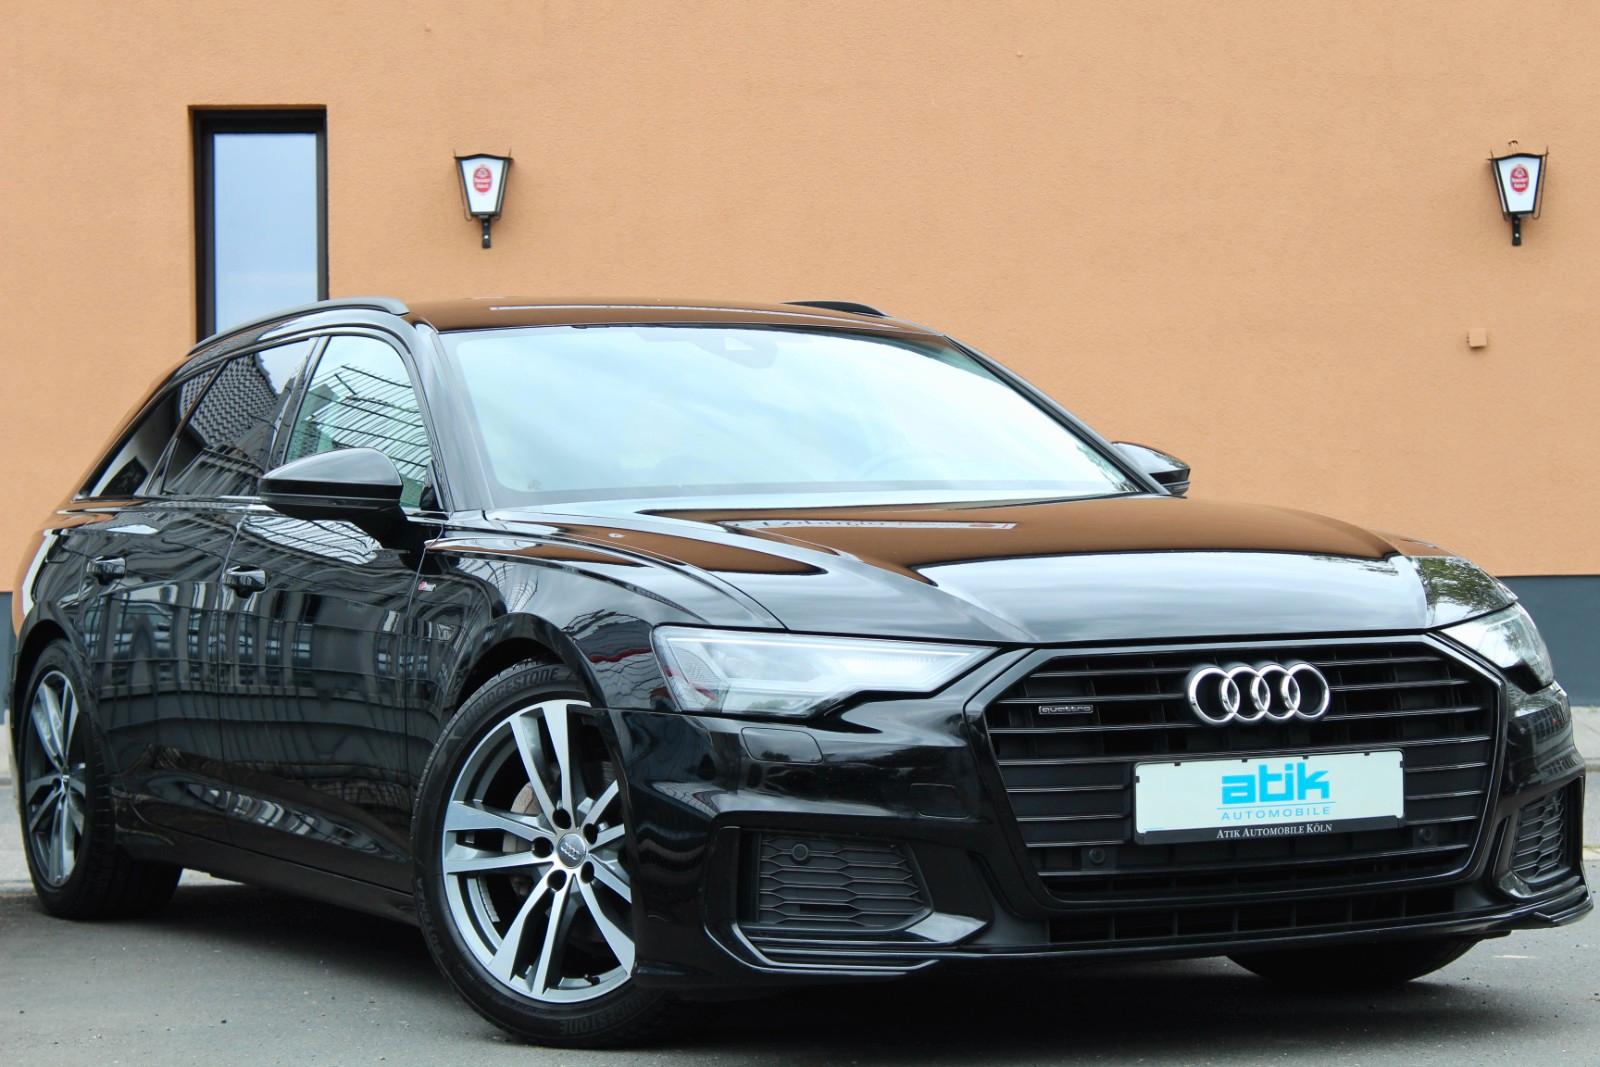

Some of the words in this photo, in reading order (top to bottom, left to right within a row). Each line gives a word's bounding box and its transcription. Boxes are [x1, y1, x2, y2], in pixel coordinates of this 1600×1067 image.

[1041, 706, 1091, 714] quattro
[1222, 762, 1330, 805] atik
[1221, 806, 1331, 821] AUTOMOBILE
[1216, 828, 1240, 839] ATIK
[1242, 825, 1304, 838] AUTOMOBILE
[1306, 823, 1333, 834] KÖLN
